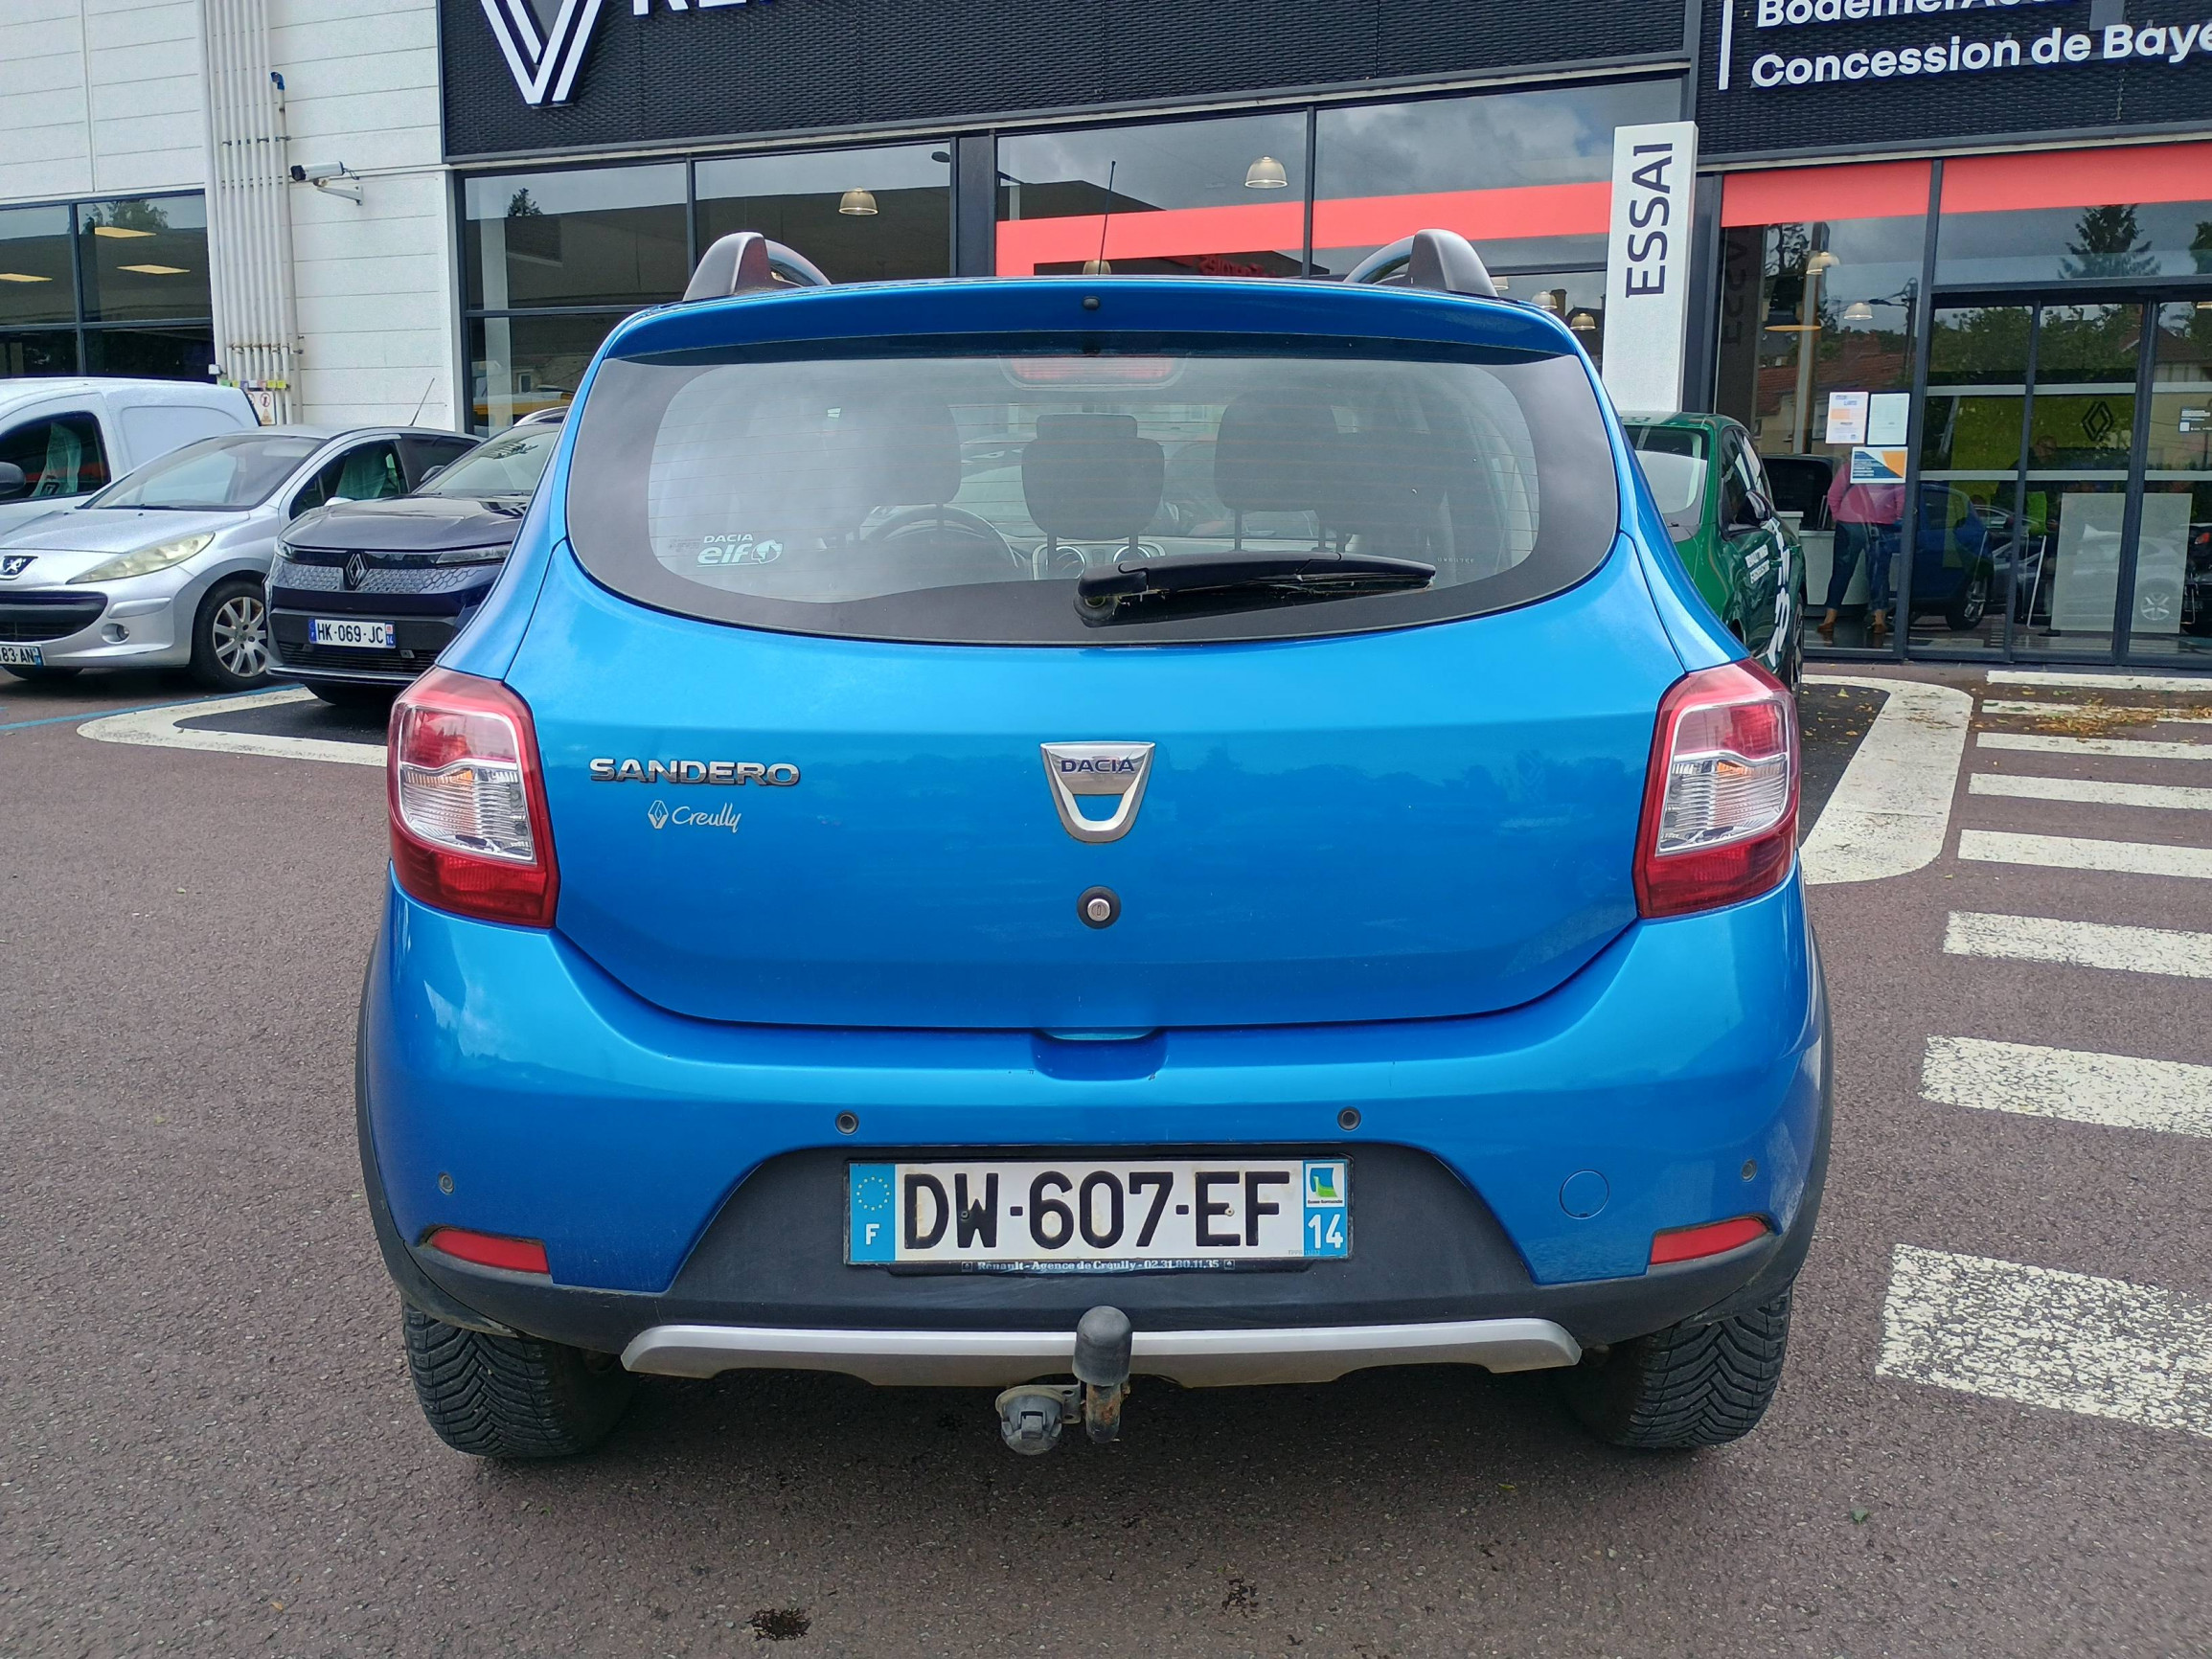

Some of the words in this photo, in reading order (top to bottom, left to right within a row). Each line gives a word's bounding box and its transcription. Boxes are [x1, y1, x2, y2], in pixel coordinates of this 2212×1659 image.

[1751, 33, 2021, 87] Concession
[2031, 27, 2091, 65] de
[1625, 143, 1674, 299] ESSAI
[703, 534, 754, 544] DACIA
[696, 543, 753, 563] elf
[317, 623, 383, 644] HK-069-JC
[0, 648, 35, 663] 83-AN
[589, 758, 801, 786] SANDERO
[1060, 759, 1135, 773] DACIA
[672, 802, 742, 833] Creully
[904, 1170, 1290, 1250] DW-607-EF
[865, 1223, 880, 1245] F
[1308, 1214, 1344, 1249] 14
[977, 1261, 1024, 1271] Renault
[1031, 1261, 1074, 1273] Agence
[1076, 1261, 1091, 1270] de
[1093, 1260, 1136, 1271] Creully
